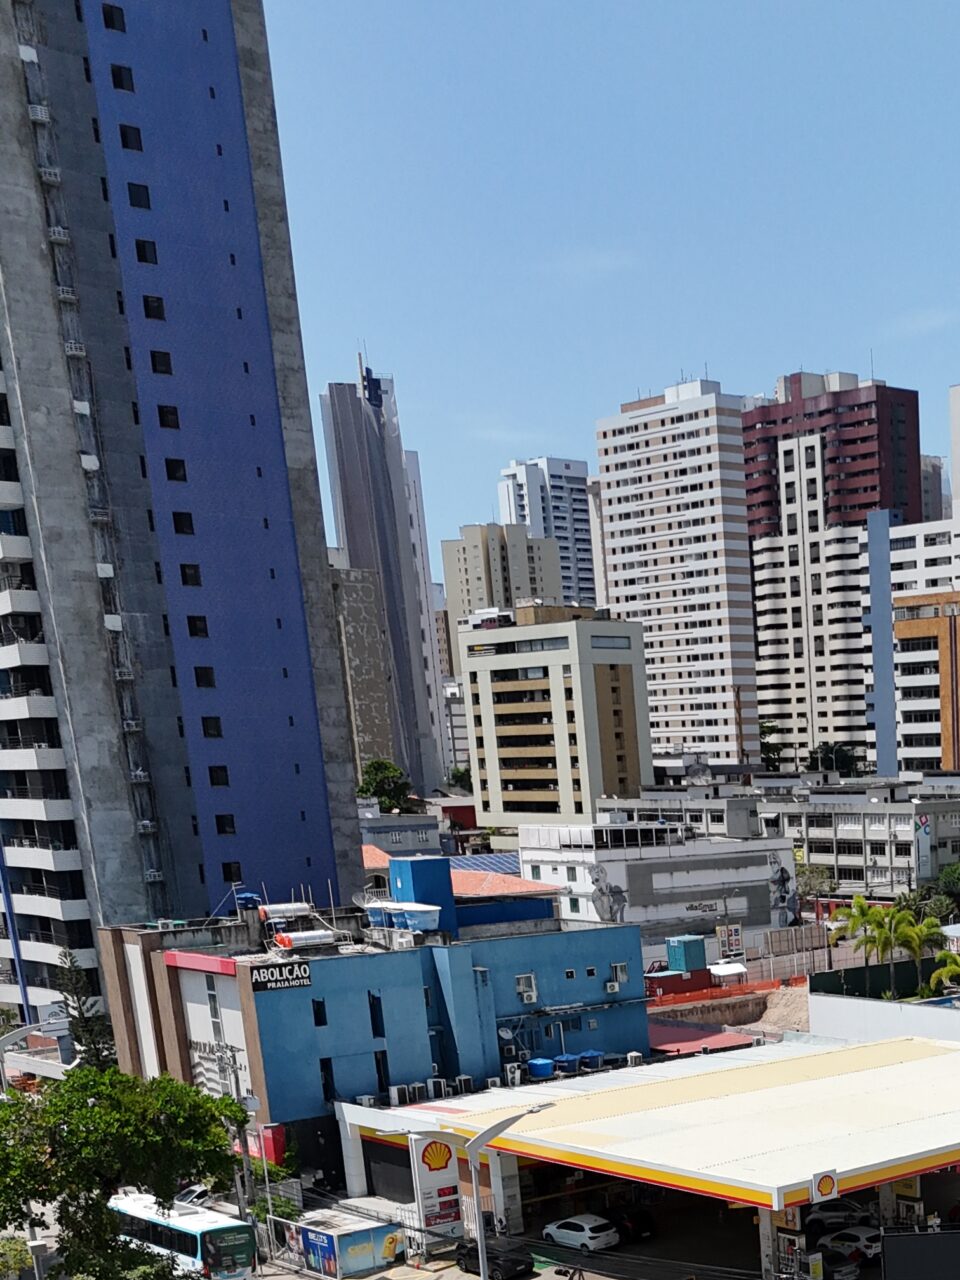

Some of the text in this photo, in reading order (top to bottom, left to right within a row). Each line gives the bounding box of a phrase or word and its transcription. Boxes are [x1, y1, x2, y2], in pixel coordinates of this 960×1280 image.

[252, 964, 310, 983] ABOLIÇÃO
[267, 978, 312, 989] PRAIA HOTEL
